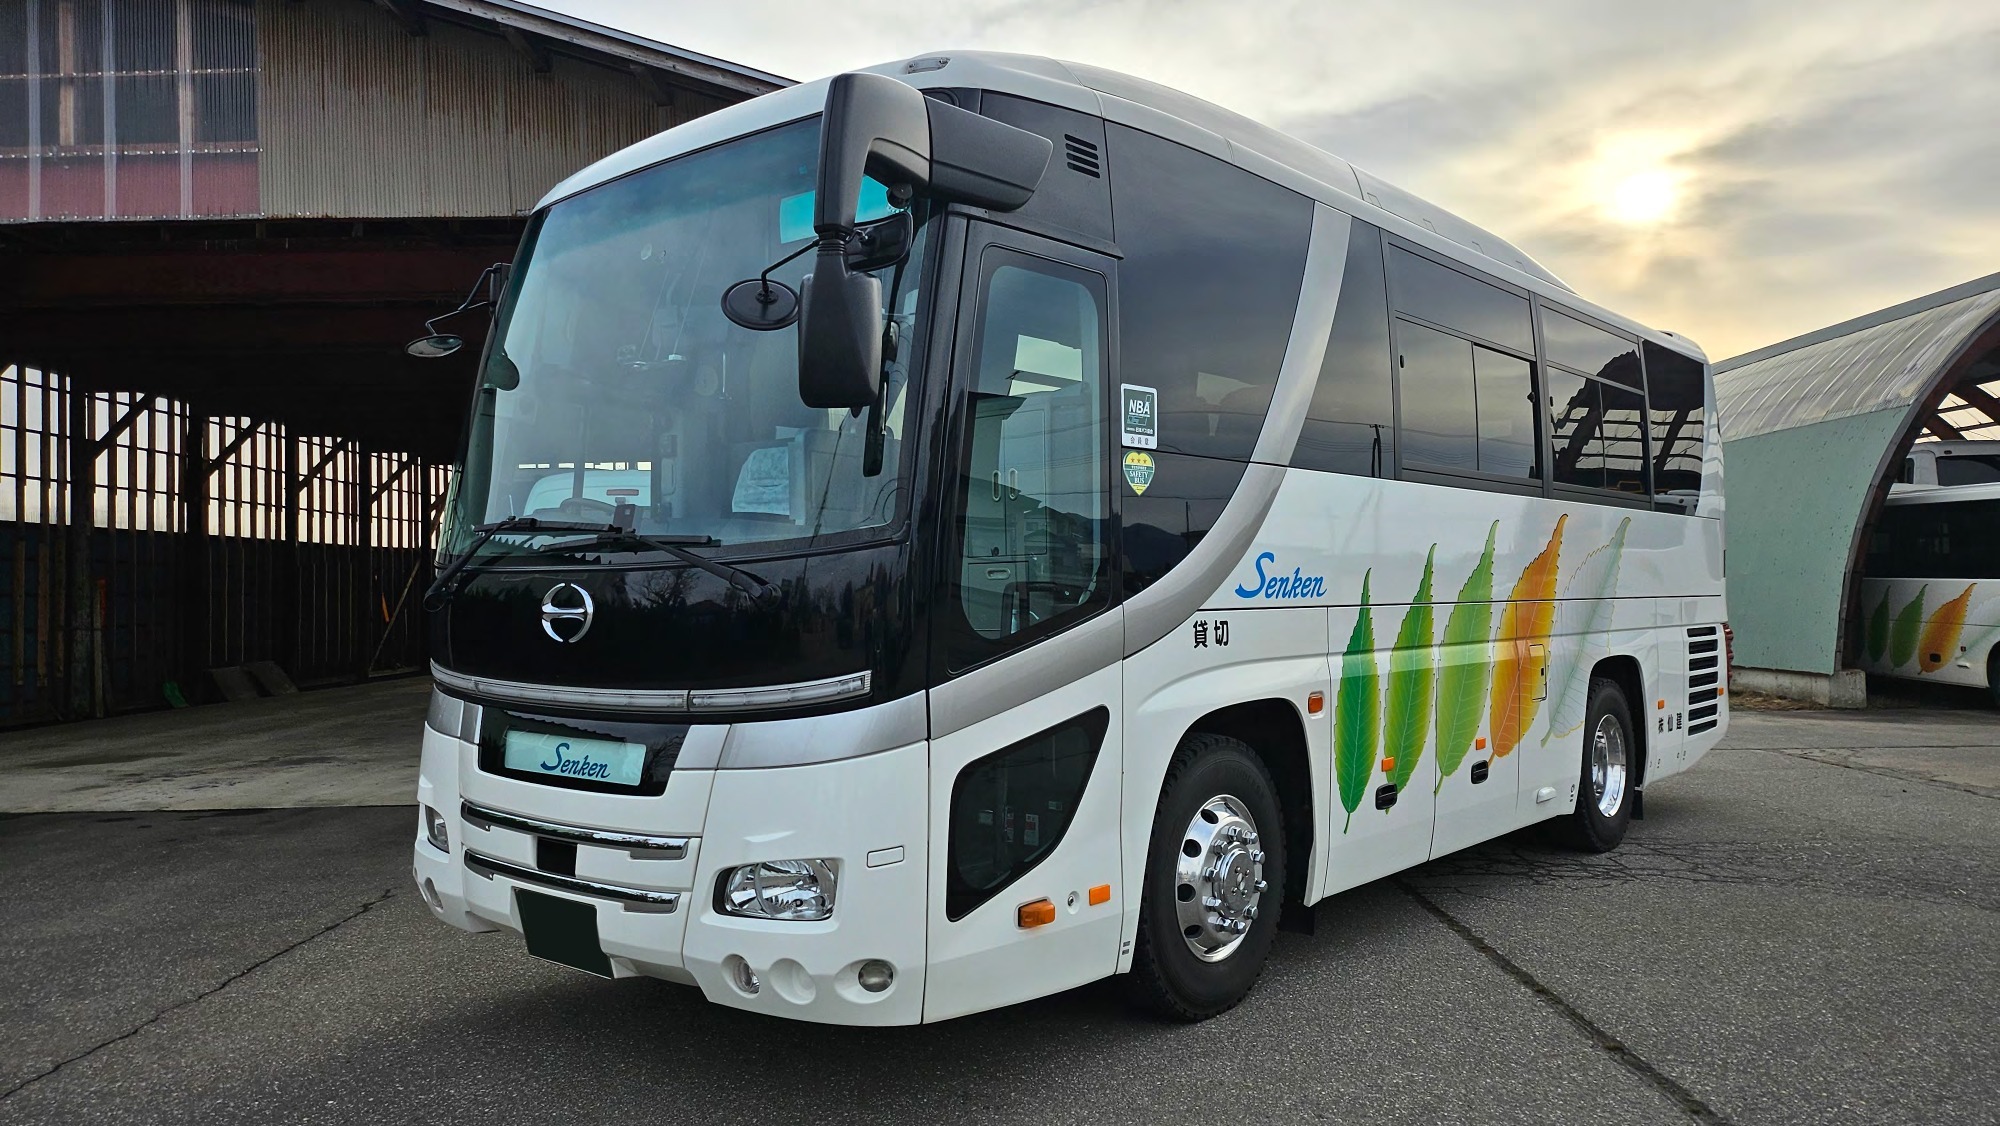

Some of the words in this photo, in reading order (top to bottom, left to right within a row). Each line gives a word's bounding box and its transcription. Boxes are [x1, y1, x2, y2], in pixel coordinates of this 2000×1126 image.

[1129, 399, 1150, 415] NBA
[1130, 470, 1149, 479] SAFETY
[1234, 551, 1328, 599] Senken
[1192, 619, 1230, 649] 貸切
[540, 742, 611, 778] Senken
